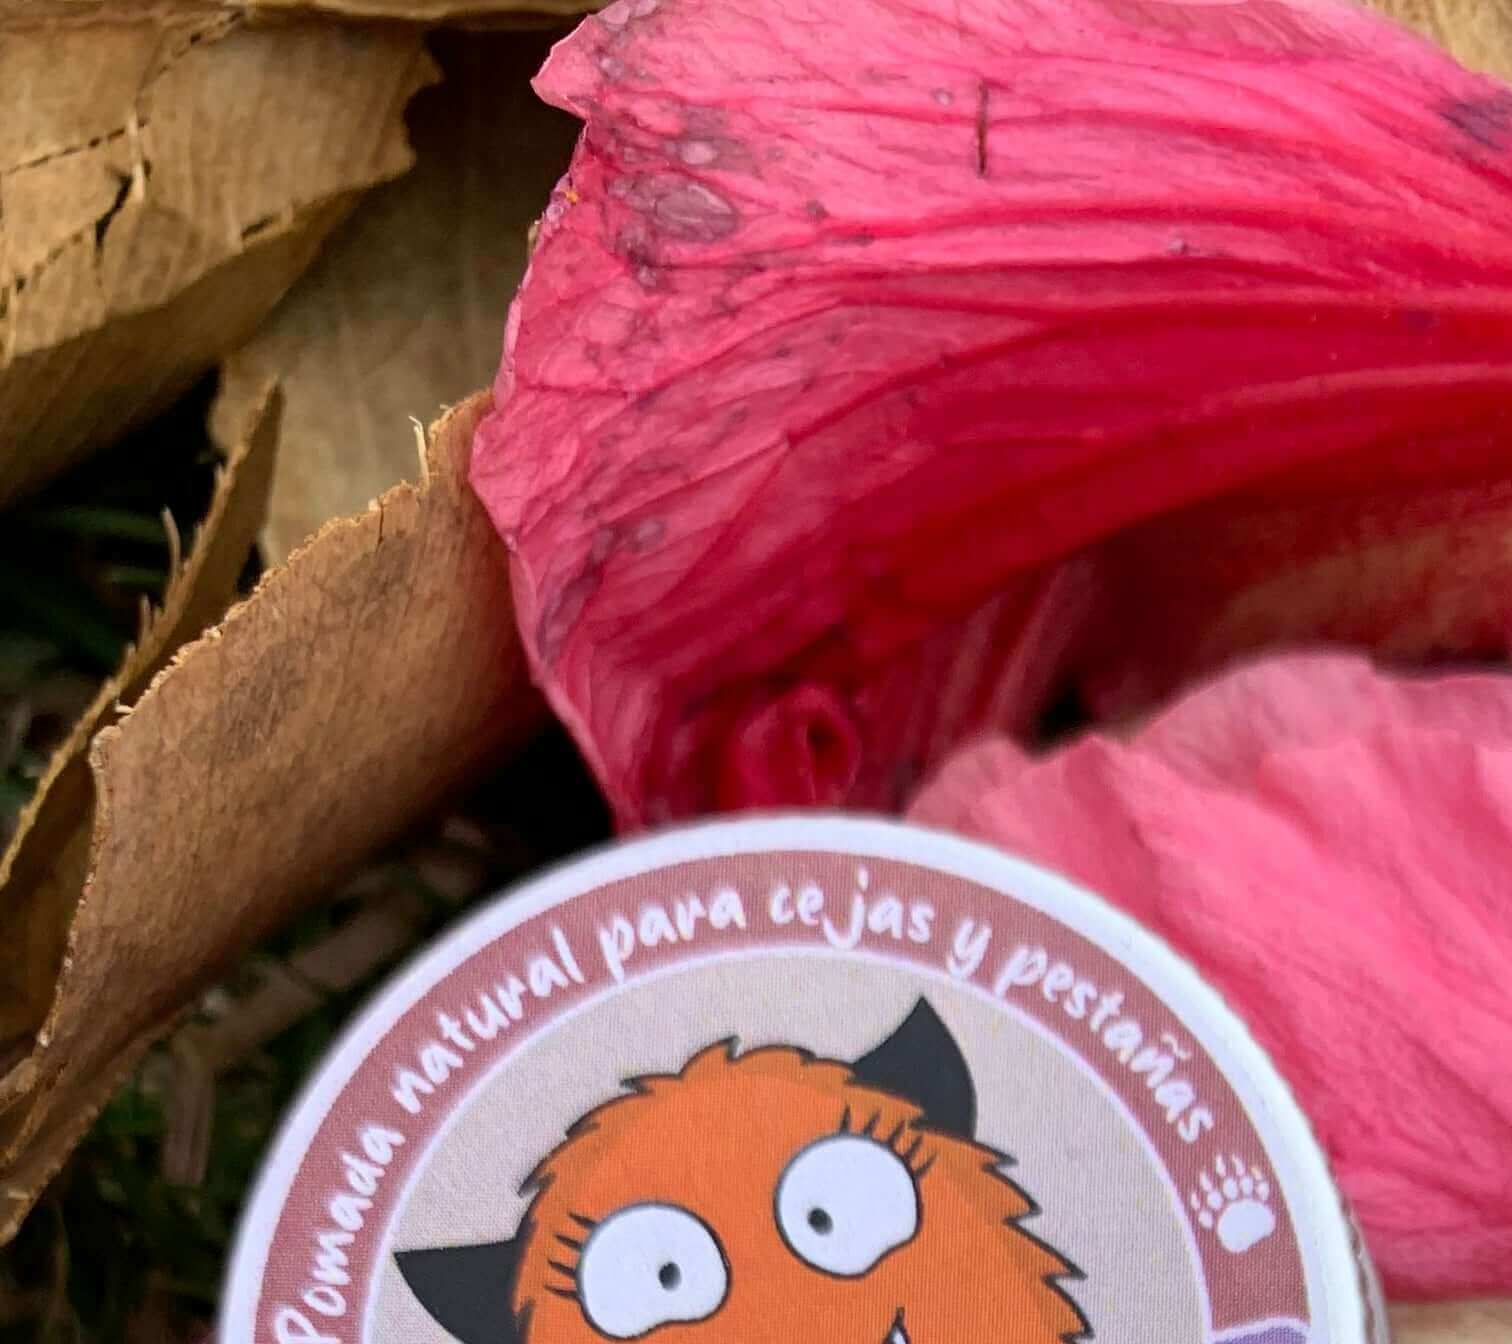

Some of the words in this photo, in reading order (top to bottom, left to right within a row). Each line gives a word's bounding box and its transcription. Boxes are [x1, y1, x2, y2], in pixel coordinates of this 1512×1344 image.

[392, 926, 586, 1116] natural
[600, 888, 747, 982] para
[950, 923, 992, 977] y
[995, 943, 1213, 1144] pestañas
